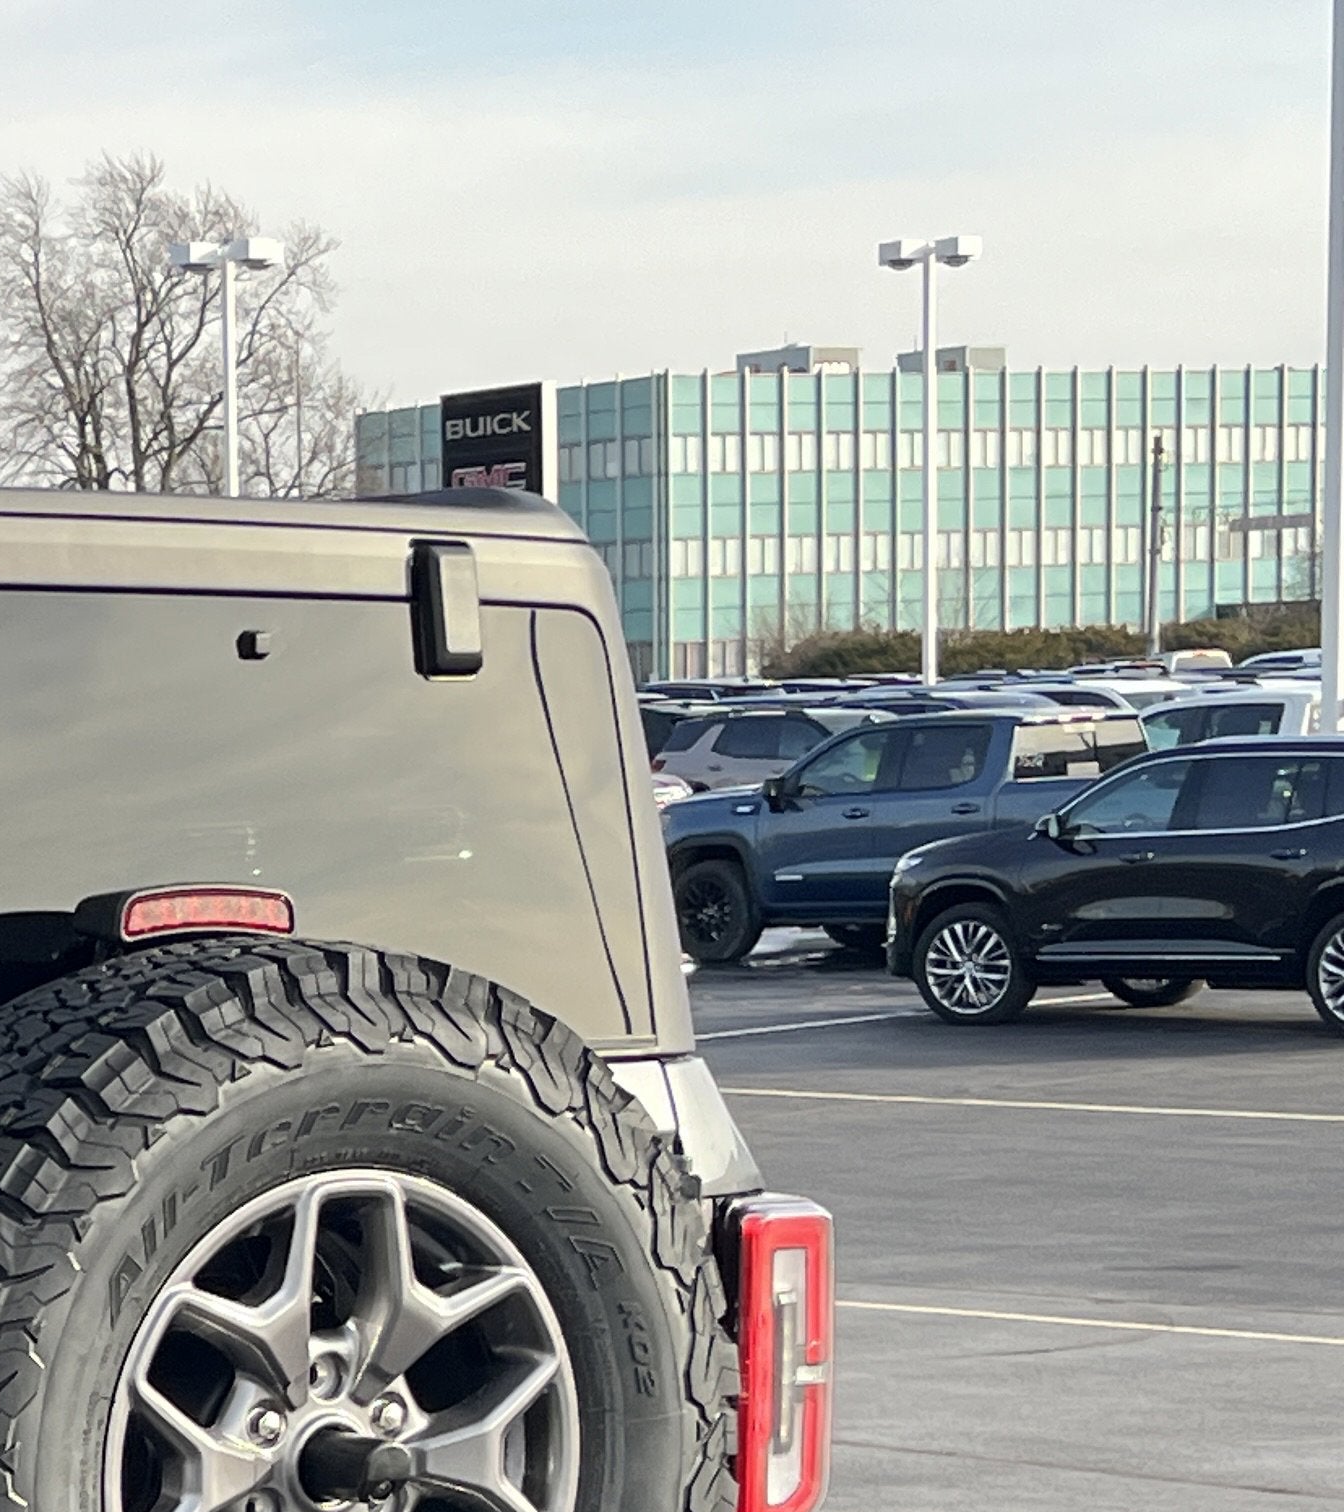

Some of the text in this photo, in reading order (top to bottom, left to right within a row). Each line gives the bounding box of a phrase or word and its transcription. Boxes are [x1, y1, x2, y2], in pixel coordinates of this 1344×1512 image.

[445, 411, 531, 440] BUICK
[451, 462, 527, 490] GMC
[517, 1153, 625, 1291] T/A
